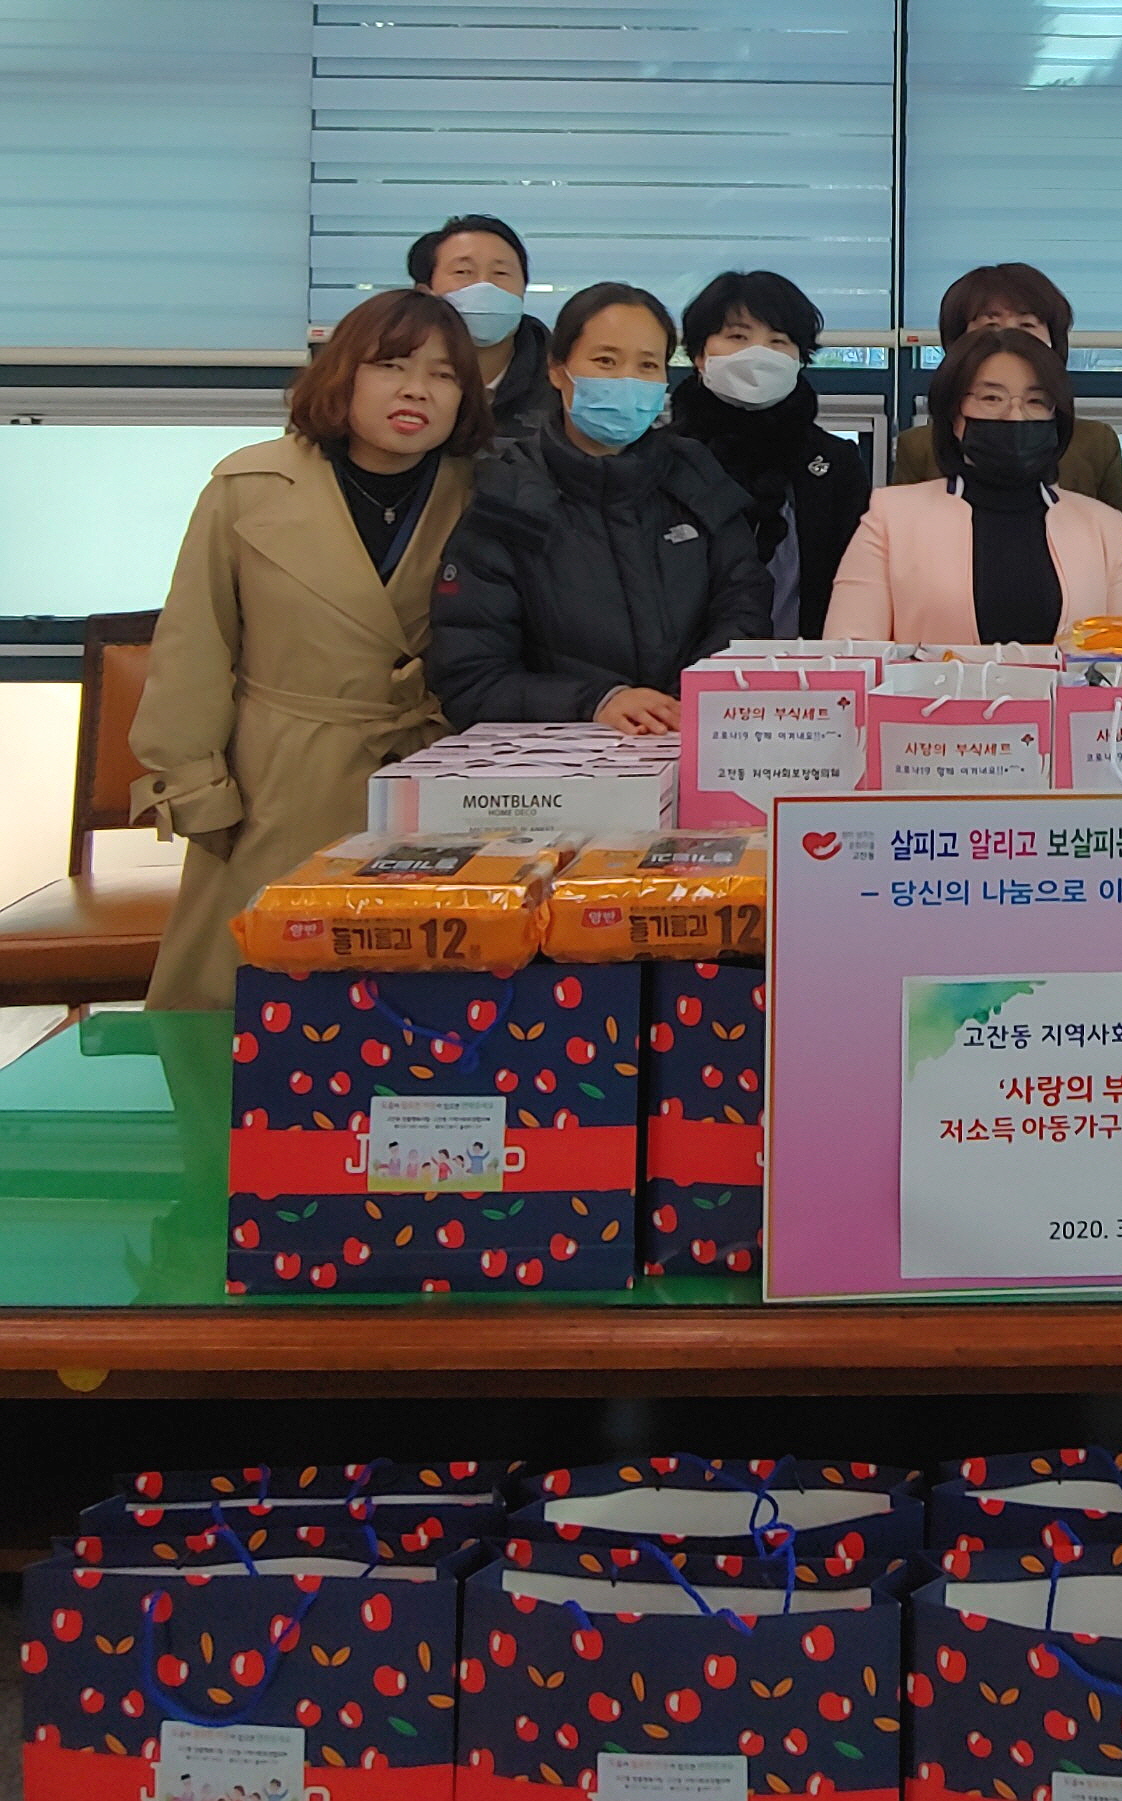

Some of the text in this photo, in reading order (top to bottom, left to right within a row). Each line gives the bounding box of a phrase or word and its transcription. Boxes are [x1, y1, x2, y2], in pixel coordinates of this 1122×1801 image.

[775, 706, 831, 721] 부식세트
[957, 742, 1013, 757] 부식세트
[1087, 752, 1122, 763] 코로나9
[717, 768, 745, 780] 고잔동
[463, 794, 563, 808] MONTBLANC
[890, 828, 960, 860] 살피고
[969, 828, 1038, 859] 알리고
[891, 878, 970, 907] 당신의
[983, 878, 1087, 904] 나눔으로
[714, 904, 761, 948] 12
[419, 917, 467, 960] 12
[963, 1024, 1033, 1050] 고잔동
[939, 1115, 1016, 1143] 저소득
[1022, 1113, 1122, 1141] 아동가구
[1049, 1219, 1109, 1240] 2020.
